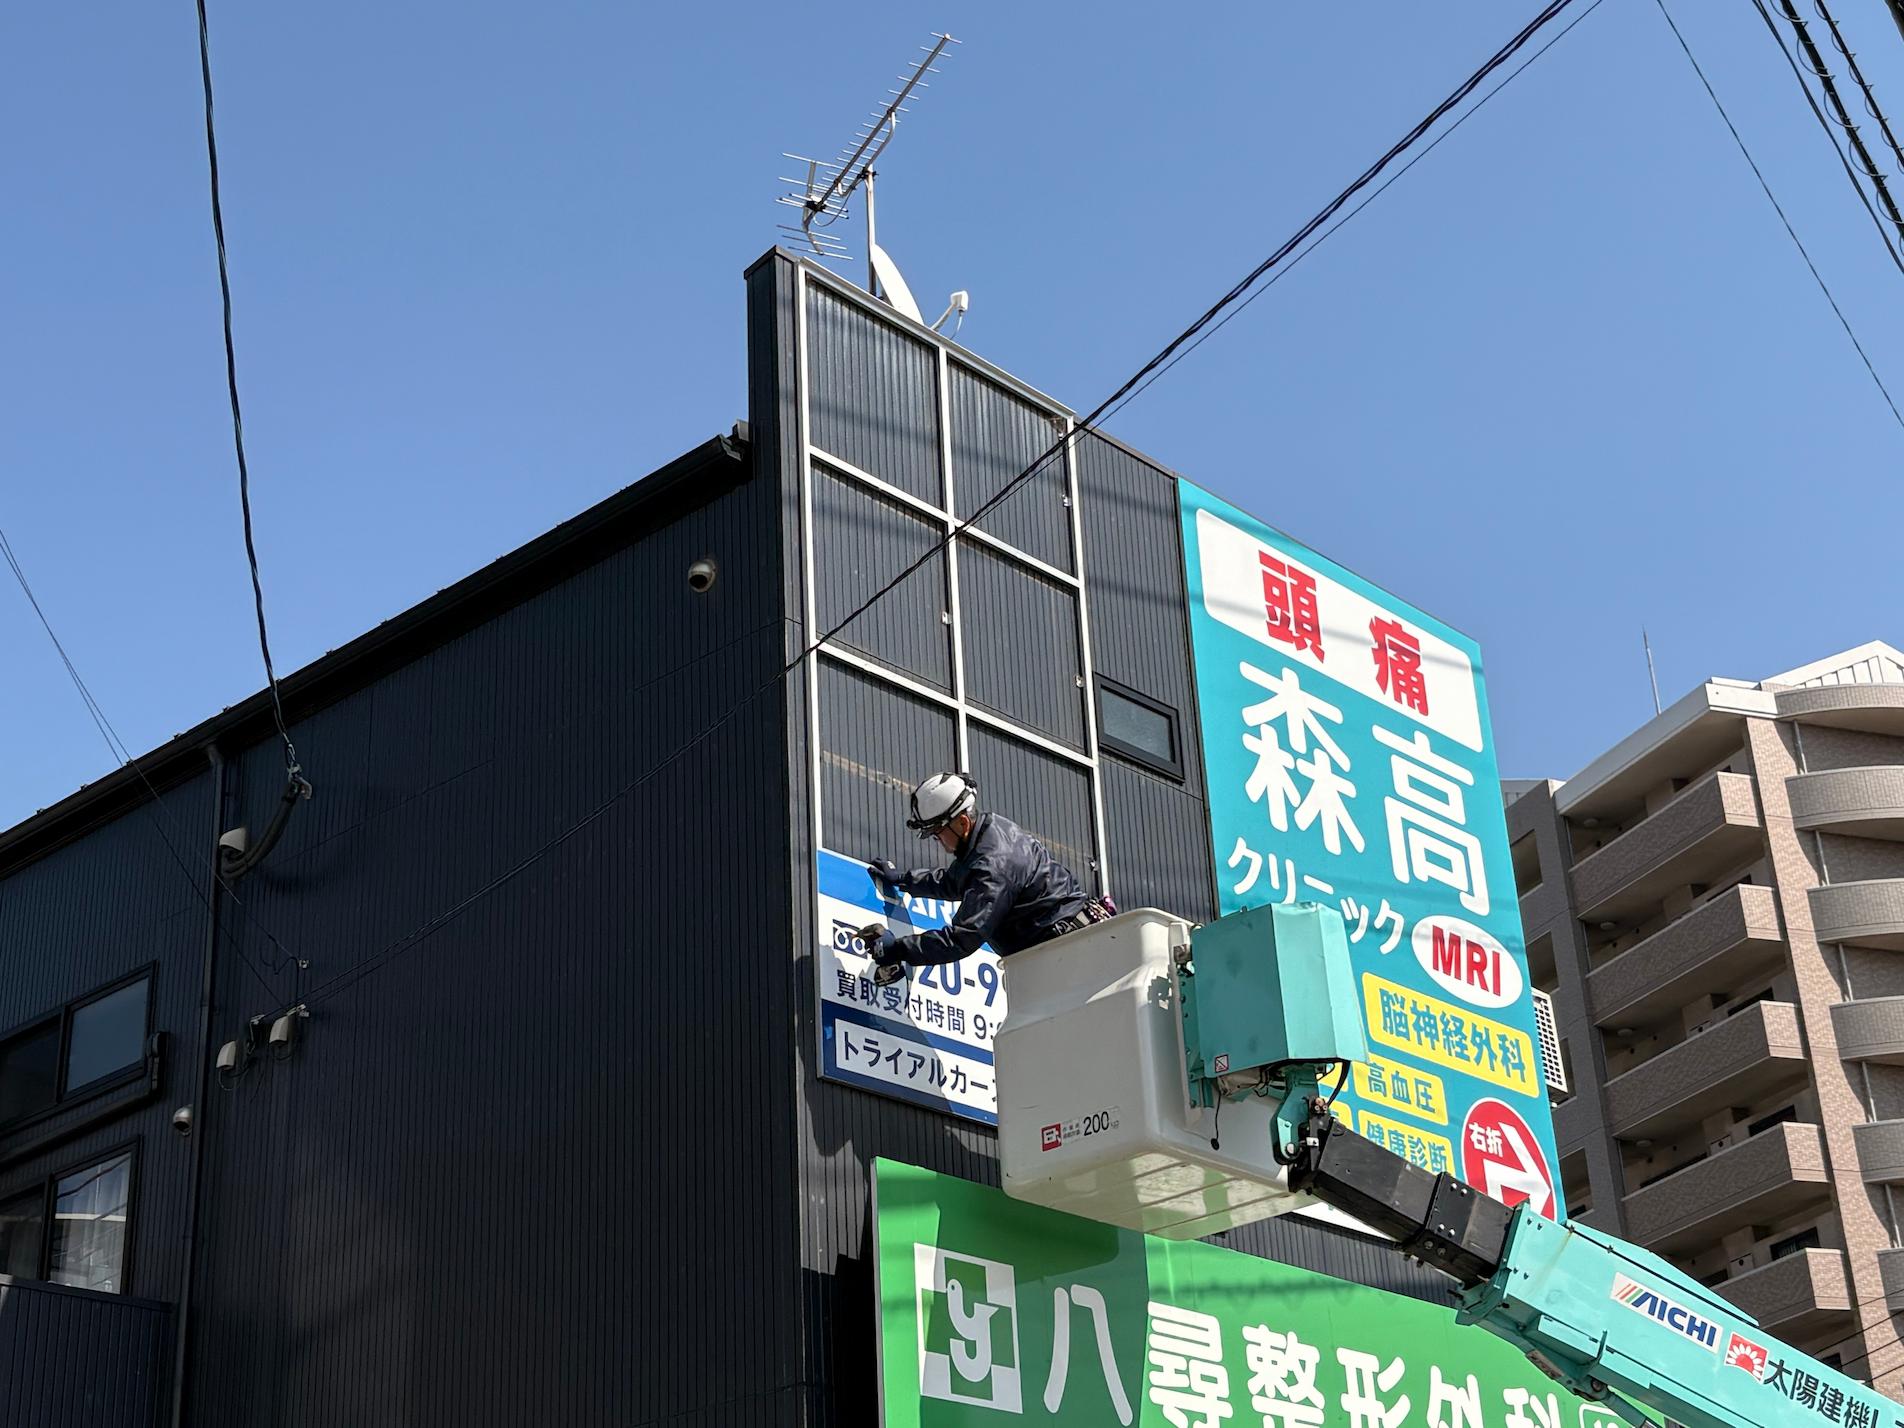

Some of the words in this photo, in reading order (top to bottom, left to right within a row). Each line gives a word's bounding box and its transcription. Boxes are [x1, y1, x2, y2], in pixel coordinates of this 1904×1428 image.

[1259, 550, 1429, 717] 頭痛
[1239, 661, 1490, 916] 森高
[1432, 924, 1501, 997] MRI
[836, 969, 965, 1035] 買取受付時間
[973, 1014, 1002, 1041] 9:
[1379, 987, 1527, 1084] 脳神経外科
[843, 1031, 997, 1102] トライアルカー
[1366, 1062, 1436, 1114] 高血圧
[1083, 1111, 1110, 1136] 200
[1468, 1122, 1504, 1158] 右折
[1632, 1291, 1718, 1347] AICHI
